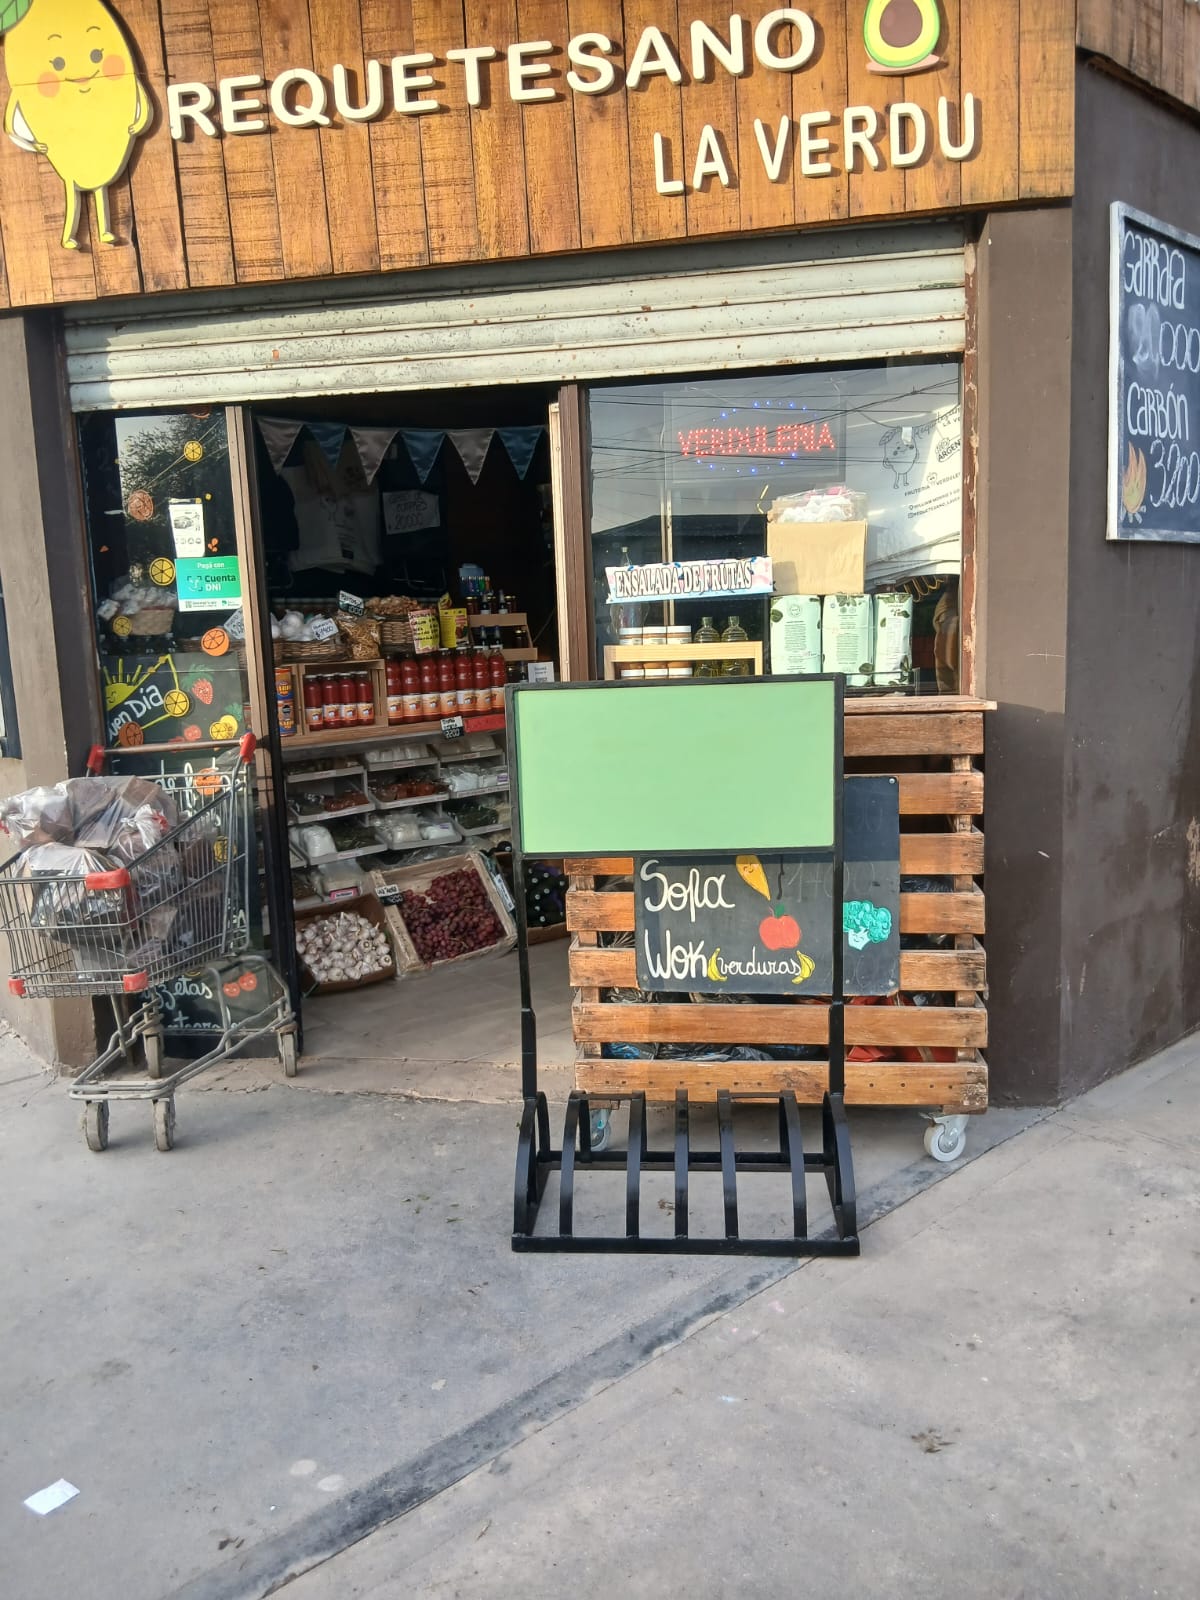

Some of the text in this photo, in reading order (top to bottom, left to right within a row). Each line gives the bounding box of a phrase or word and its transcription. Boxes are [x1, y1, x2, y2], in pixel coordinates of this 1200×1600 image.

[167, 7, 817, 141] REQUETESANO
[652, 92, 977, 196] LA VERDU
[677, 422, 836, 457] VERDULERIA
[204, 574, 237, 583] Cuenta
[205, 583, 222, 592] DNI
[614, 560, 753, 599] ENSALADA DE FRUTAS
[717, 946, 801, 976] verduras
